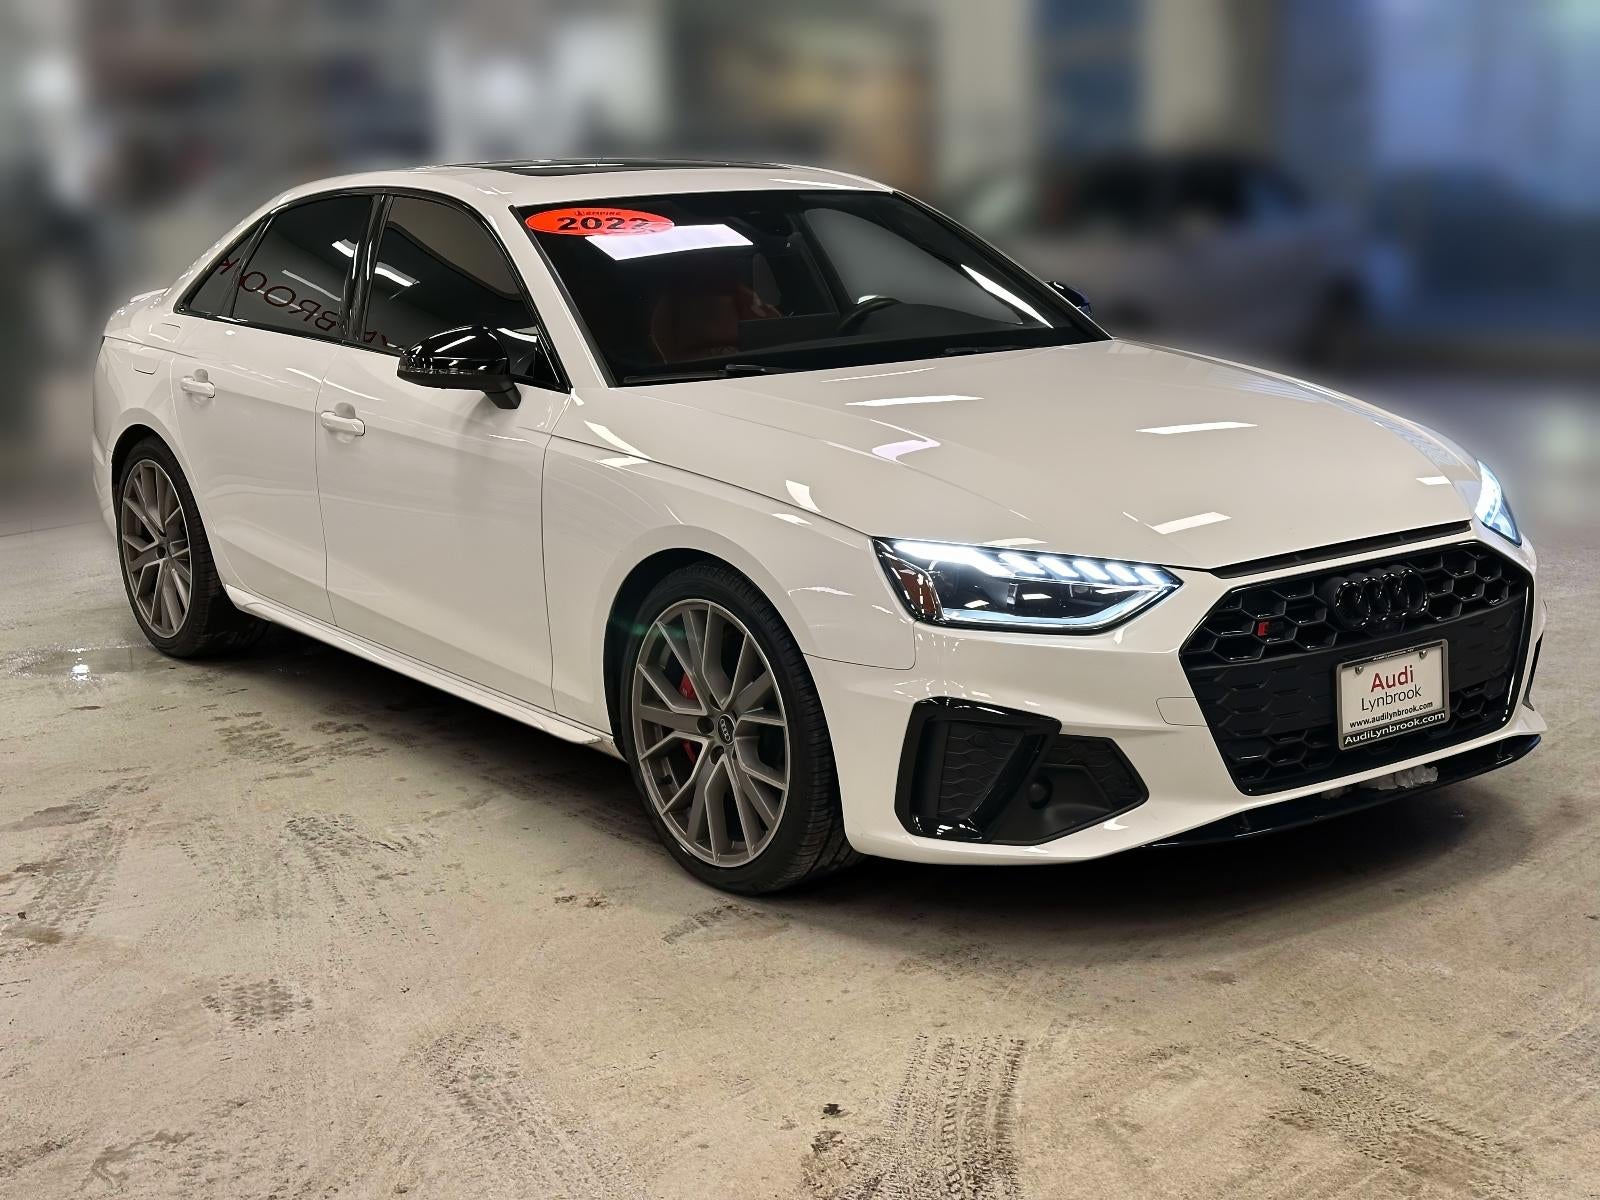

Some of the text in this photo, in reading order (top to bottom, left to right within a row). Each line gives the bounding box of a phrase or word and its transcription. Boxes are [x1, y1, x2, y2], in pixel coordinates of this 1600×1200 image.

[557, 217, 650, 230] 2022
[1370, 664, 1414, 693] Audi
[1361, 684, 1422, 712] Lynbrook
[1344, 712, 1445, 745] AudiLynbrook.com
[1349, 701, 1434, 728] www.audilynbrook.com
